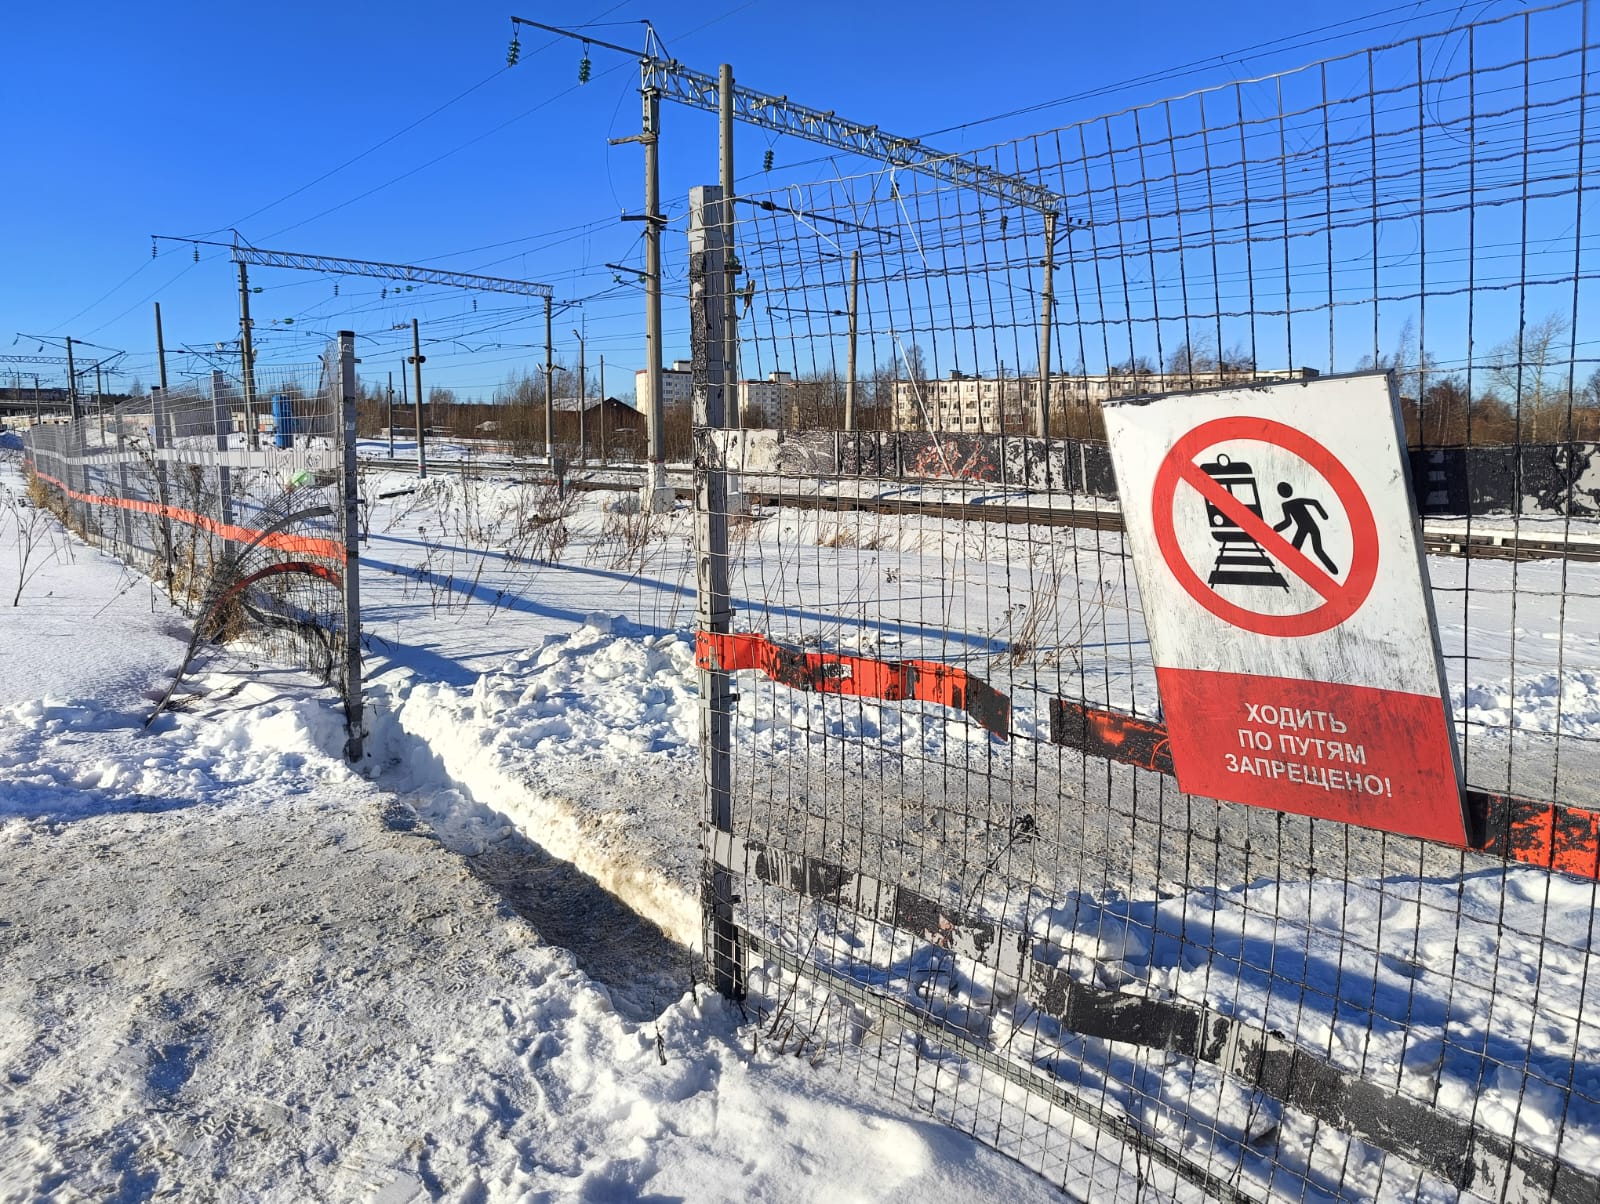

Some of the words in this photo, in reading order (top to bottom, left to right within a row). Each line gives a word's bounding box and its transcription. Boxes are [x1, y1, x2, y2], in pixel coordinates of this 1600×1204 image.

[1245, 702, 1348, 734] ХОДИТЬ
[1238, 729, 1272, 751] ПО
[1279, 734, 1367, 765] ПУТЯМ
[1225, 753, 1392, 798] ЗАПРЕЩЕНО!
